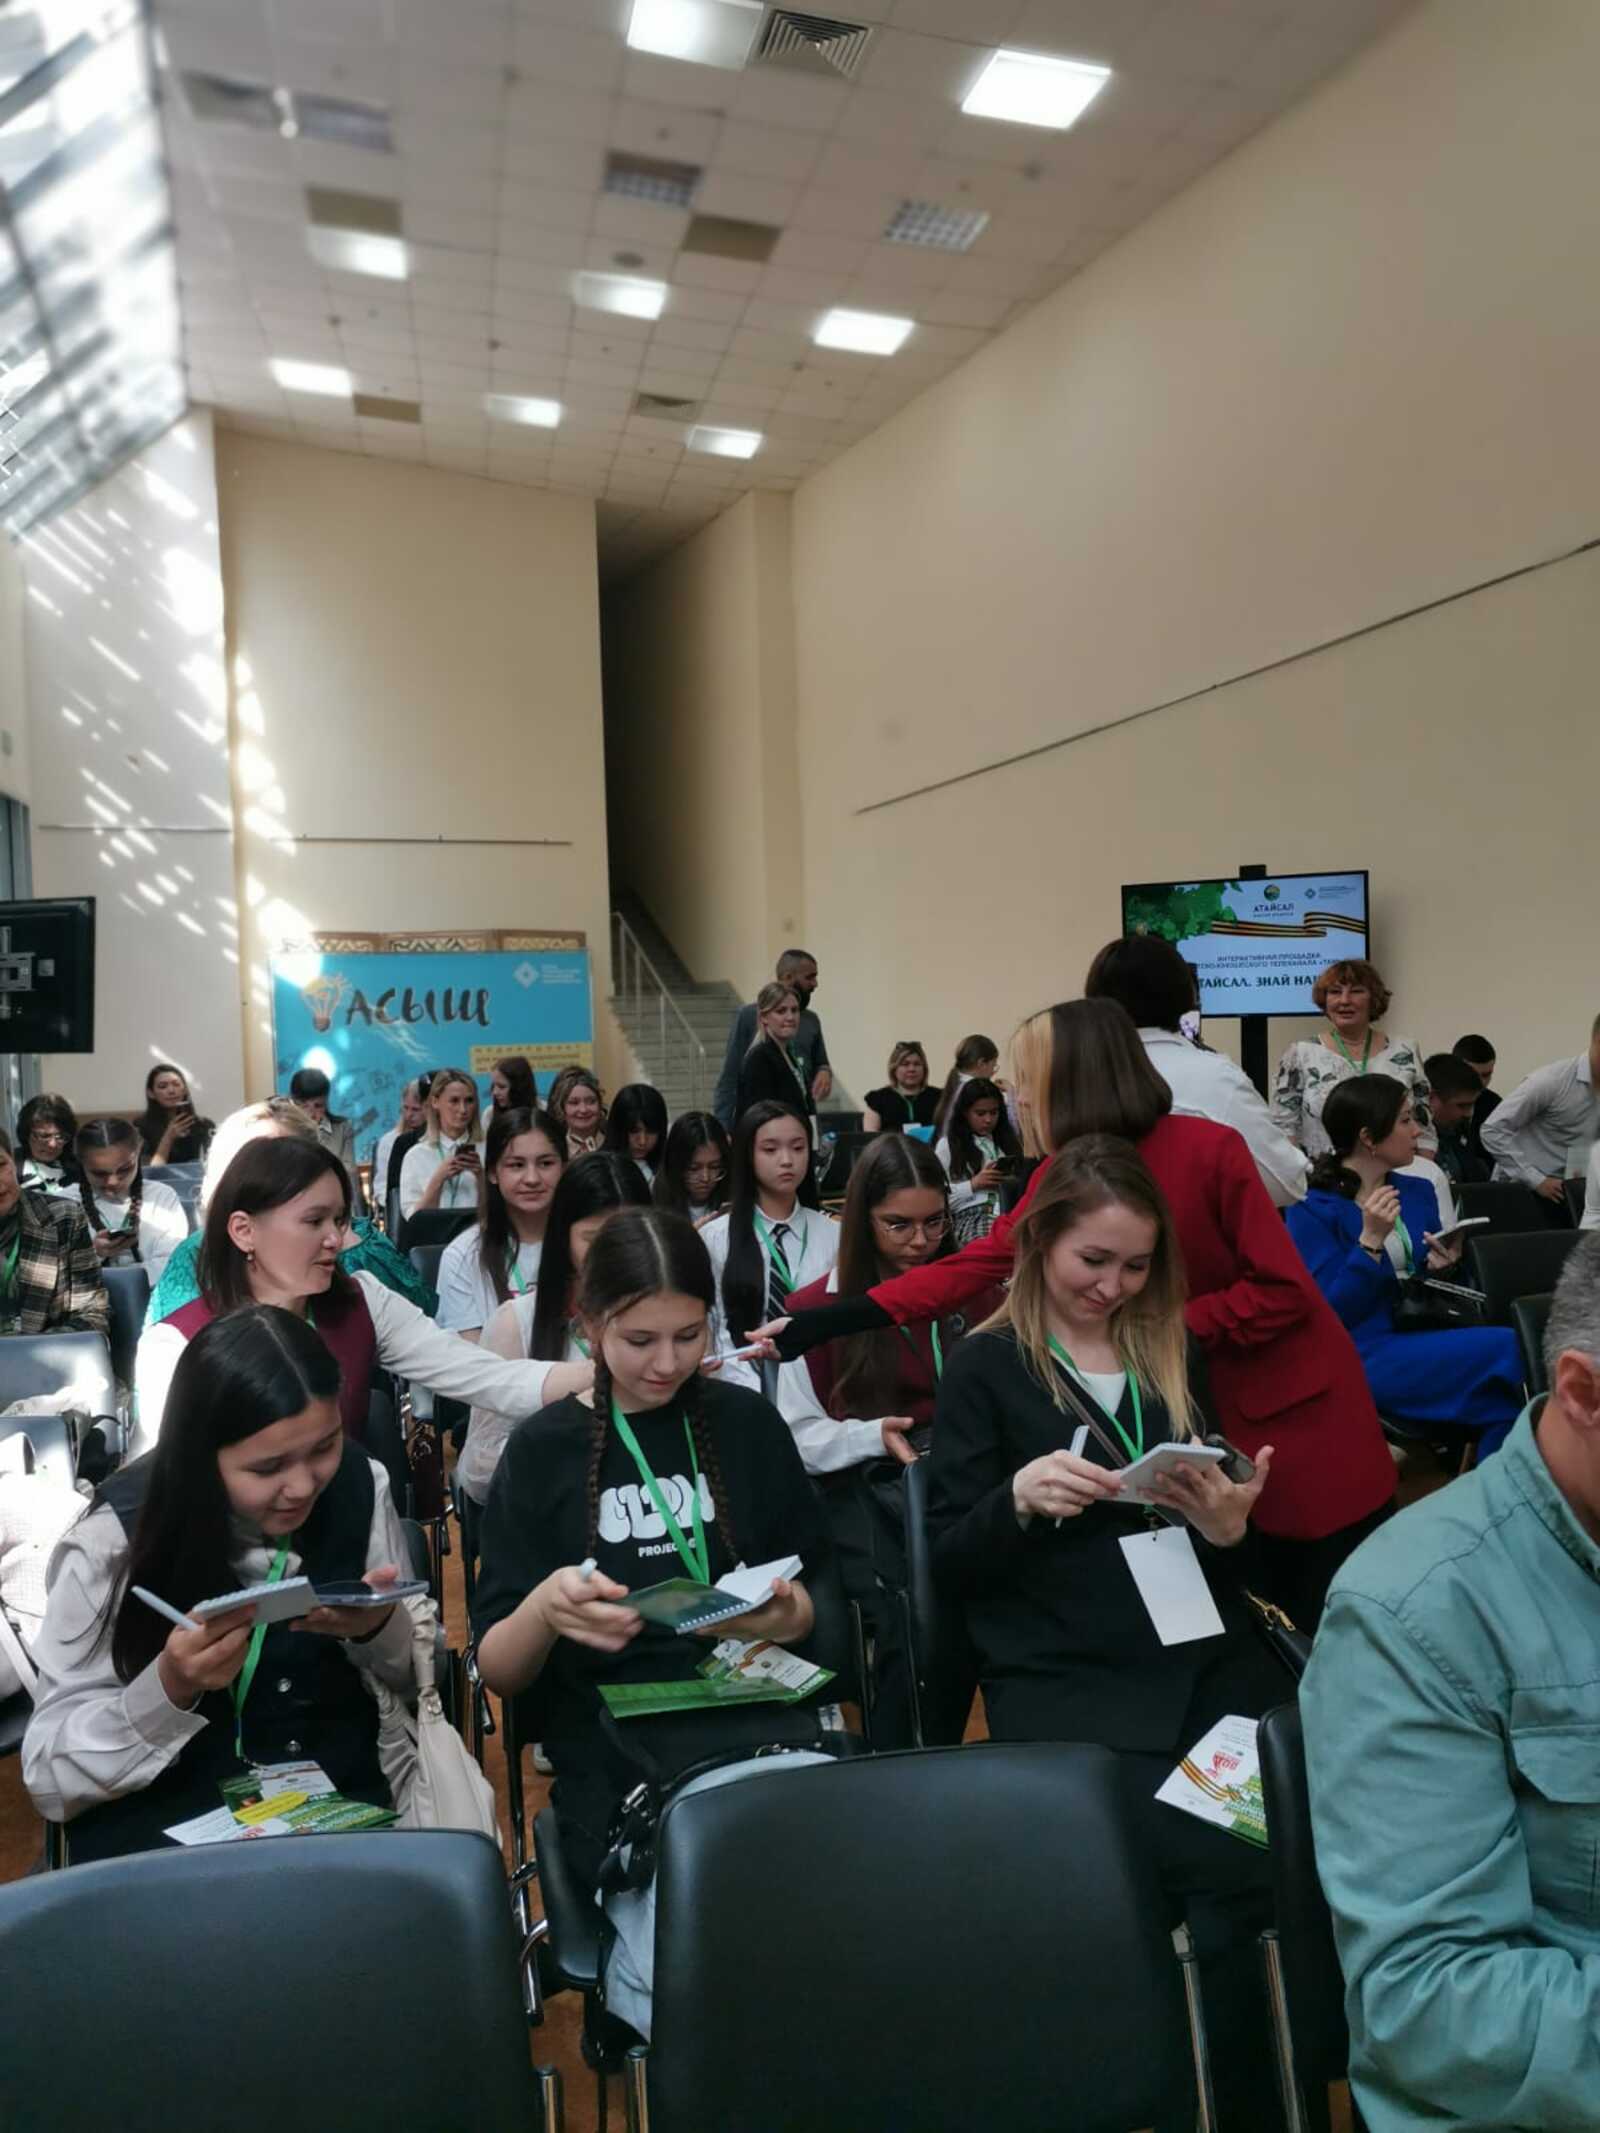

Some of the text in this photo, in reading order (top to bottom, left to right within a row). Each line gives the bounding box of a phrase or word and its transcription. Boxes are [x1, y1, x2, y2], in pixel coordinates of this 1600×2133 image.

[1253, 903, 1294, 912] АТАЙСАЛ
[1199, 973, 1317, 988] ТАЙСАЛ. ЗНАЙ НА
[637, 1543, 679, 1558] PROJEC
